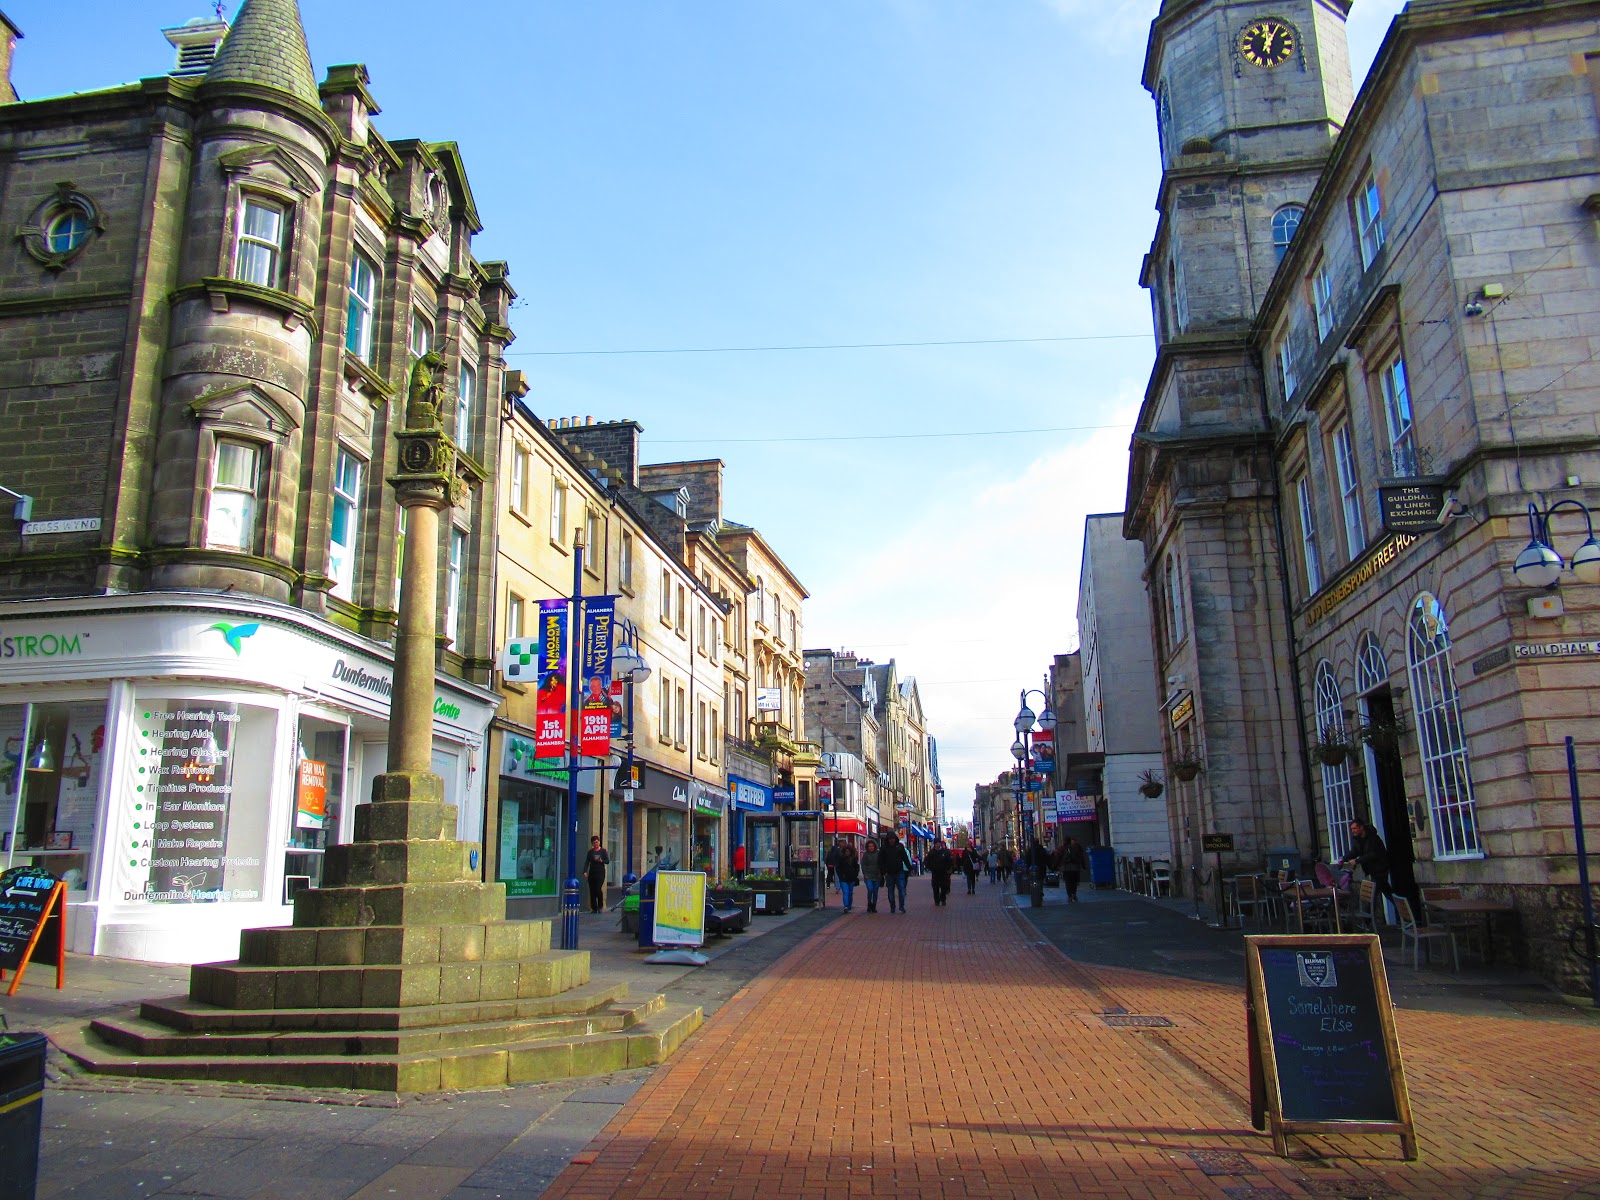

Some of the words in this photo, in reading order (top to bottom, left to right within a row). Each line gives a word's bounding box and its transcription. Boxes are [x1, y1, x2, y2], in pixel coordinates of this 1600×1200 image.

[1387, 494, 1437, 502] GUILDHALL
[1390, 509, 1438, 517] EXCHANGE
[26, 522, 59, 533] CROSS
[63, 519, 97, 530] WYND
[1321, 561, 1374, 614] WETHERSPOON
[1373, 541, 1396, 572] FREE
[595, 615, 610, 650] PETER
[0, 633, 81, 657] STROM
[546, 616, 560, 670] MOTOWN
[1520, 643, 1594, 656] GUILDHALL
[594, 648, 609, 674] PAN
[332, 659, 393, 697] Dunfermlin
[433, 697, 460, 720] Centre
[154, 711, 175, 720] Free
[177, 711, 215, 722] Hearing
[217, 712, 241, 722] Tests
[584, 715, 607, 725] 19th
[543, 720, 559, 729] 1st
[584, 725, 607, 734] APR
[152, 730, 190, 739] Hearing
[190, 729, 214, 738] Aids
[539, 729, 562, 739] JUN
[150, 748, 188, 758] Hearing
[191, 747, 229, 757] Glasses
[149, 765, 169, 774] Wax
[171, 765, 215, 775] Removal
[302, 762, 313, 774] EAR
[313, 763, 325, 776] WAX
[302, 774, 325, 788] REMOVAL
[147, 783, 186, 793] Tinnitus
[189, 783, 232, 793] Products
[737, 783, 766, 807] BETFRED
[163, 802, 181, 811] Ear
[182, 801, 226, 811] Monitors
[144, 821, 169, 831] Loop
[171, 820, 214, 831] Systems
[142, 840, 155, 848] All
[158, 839, 184, 848] Make
[186, 838, 223, 850] Repairs
[140, 858, 178, 867] Custom
[180, 857, 219, 868] Hearing
[16, 876, 34, 888] CAFE
[666, 875, 697, 884] SOUNDS
[124, 889, 189, 901] Dunfermline
[192, 889, 231, 901] Hearing
[669, 885, 691, 893] MAKE
[666, 894, 693, 910] LIFE
[1321, 1017, 1353, 1032] Else
